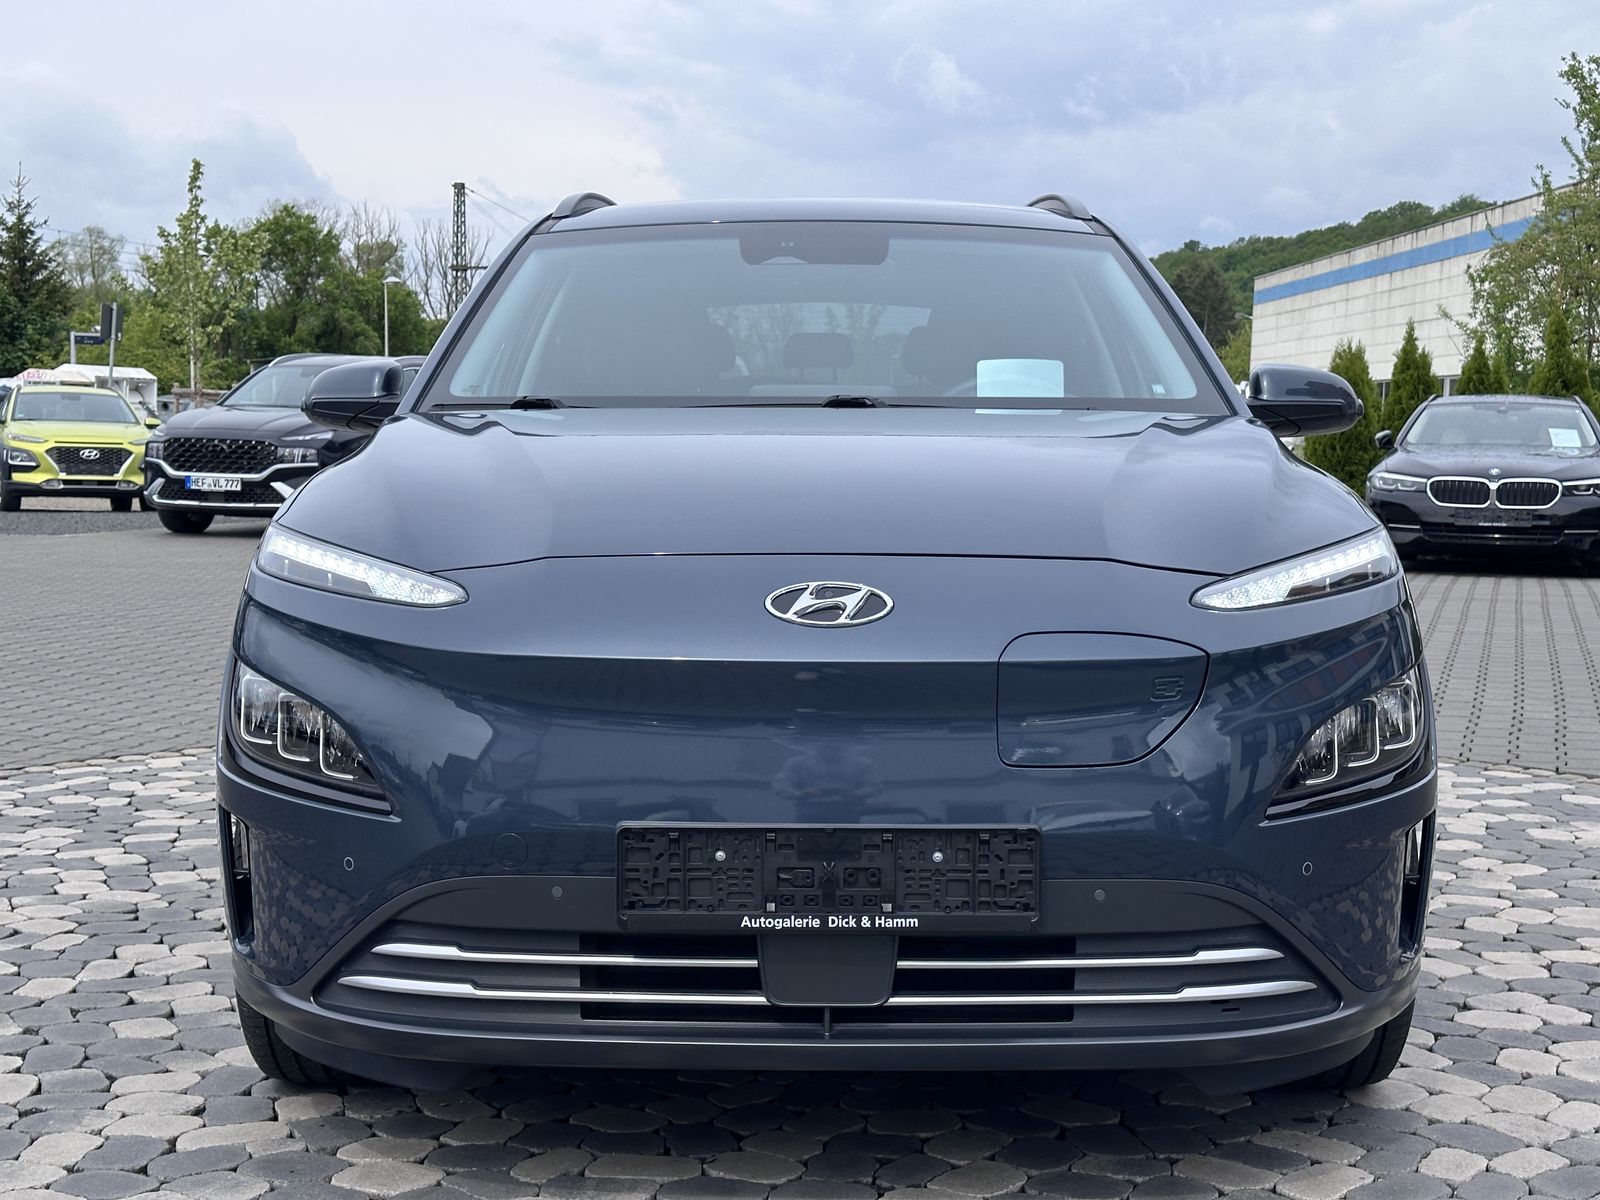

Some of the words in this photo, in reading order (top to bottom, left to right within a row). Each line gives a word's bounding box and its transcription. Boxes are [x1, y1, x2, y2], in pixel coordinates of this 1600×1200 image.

[224, 479, 240, 489] 777
[740, 915, 821, 929] Autogalerie
[828, 915, 857, 928] Dick
[861, 916, 871, 928] &
[875, 916, 919, 928] Hamm
